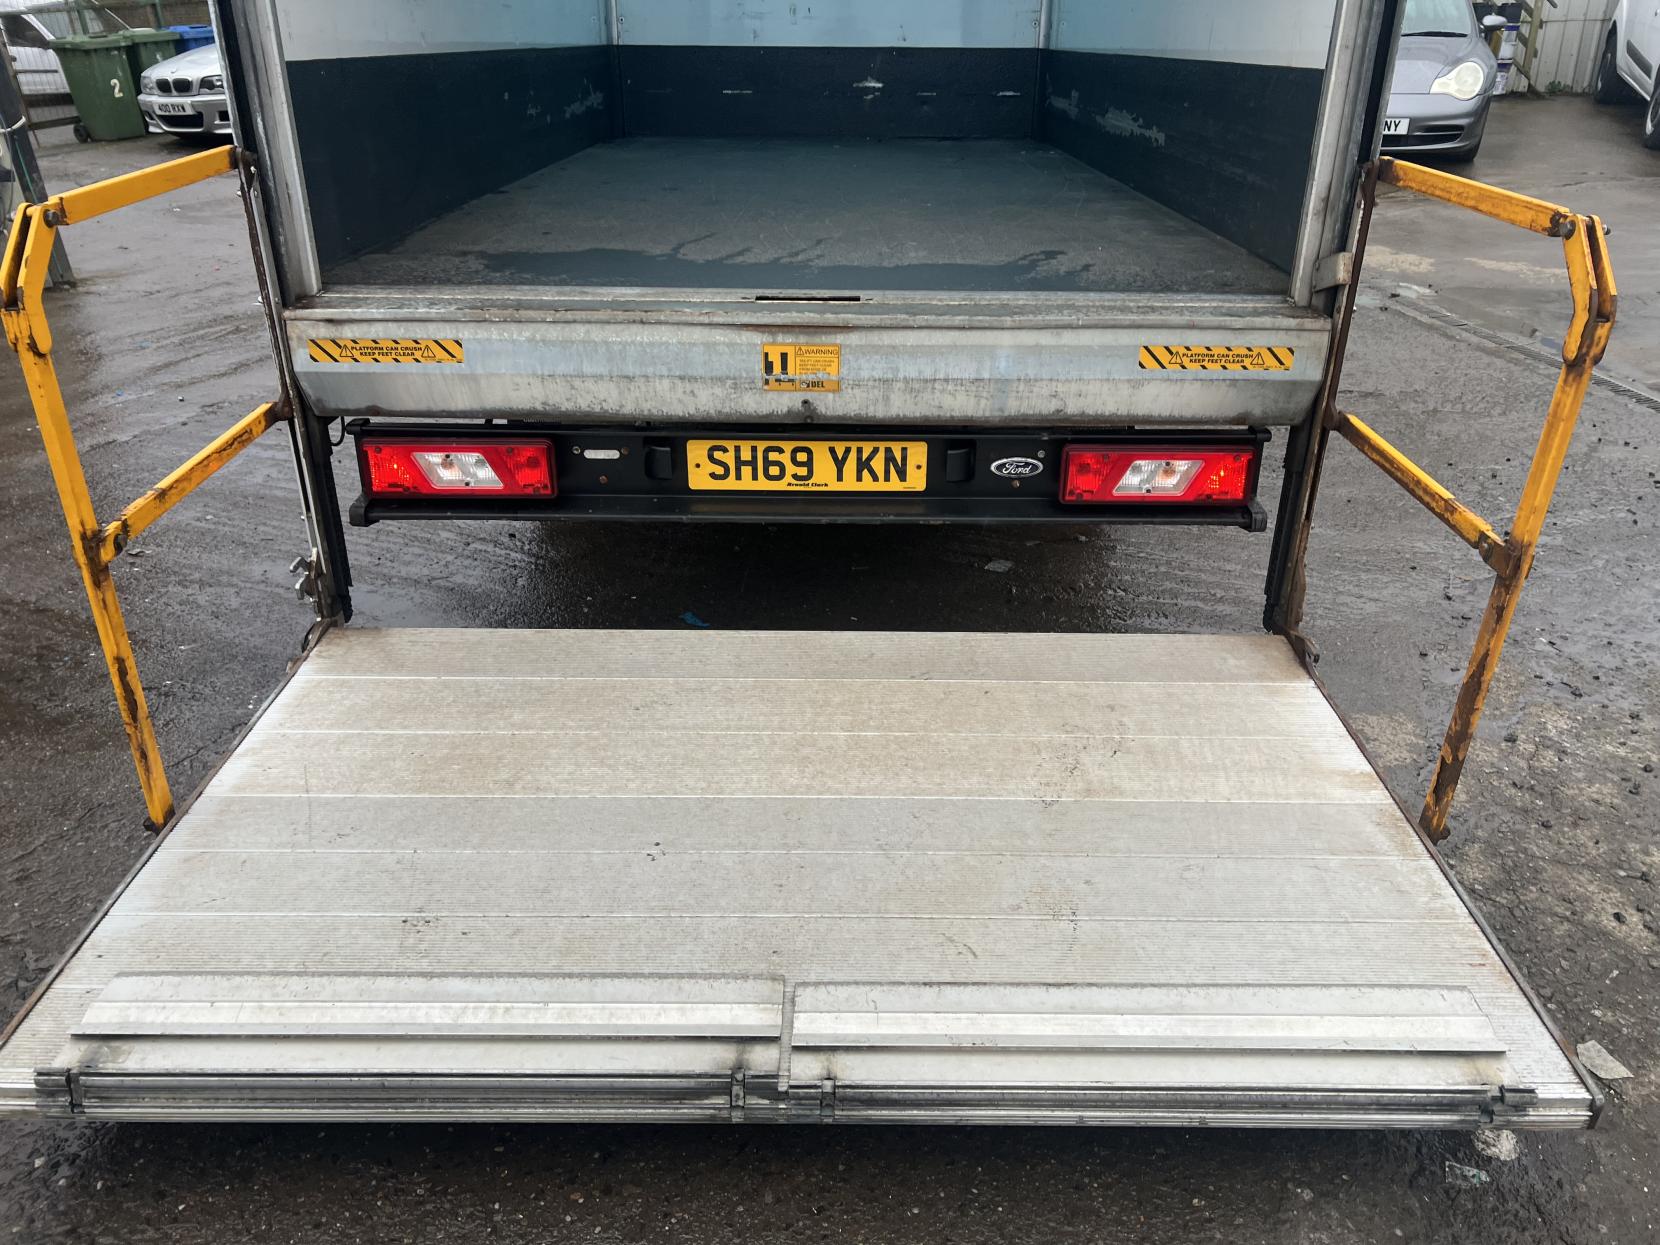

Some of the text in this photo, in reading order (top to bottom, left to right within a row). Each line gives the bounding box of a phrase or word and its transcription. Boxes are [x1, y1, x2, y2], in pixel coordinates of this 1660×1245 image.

[110, 78, 123, 98] 2
[1383, 120, 1401, 132] NY
[804, 348, 838, 356] WARNING
[707, 445, 908, 483] SH69 YKN
[1002, 462, 1032, 474] Ford
